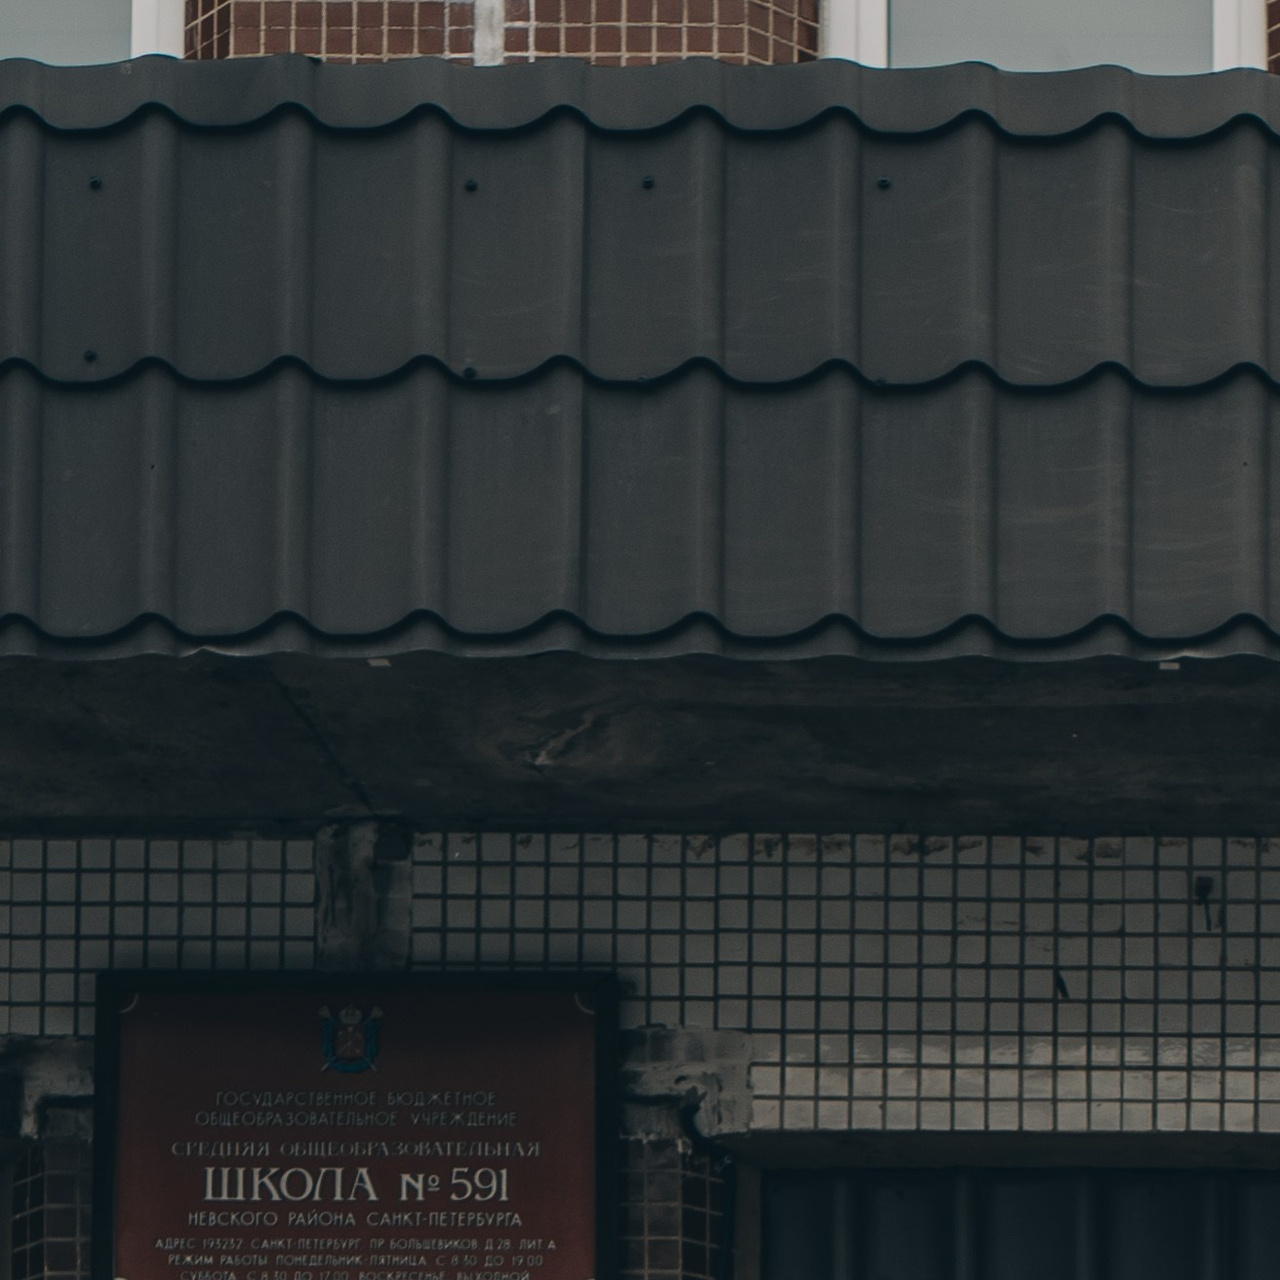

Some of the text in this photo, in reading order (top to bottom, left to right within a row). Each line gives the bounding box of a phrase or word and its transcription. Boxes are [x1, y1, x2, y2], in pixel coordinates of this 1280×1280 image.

[215, 1091, 496, 1107] ГОСУДАРСТВЕННОЕ БЮДЖЕТНОЕ
[195, 1111, 518, 1127] ОБЩЕОБРАЗОВАТЕЛЬНОЕ УЧРЕЖДЕНИЕ
[171, 1141, 541, 1158] СРЕДНЯЯ ОБЩЕОБРАЗОВАТЕЛЬНАЯ
[203, 1166, 510, 1202] ШКОЛА № 591
[188, 1208, 523, 1228] НЕВСКОГО РАЙОНА САНКТ-ПЕТЕРБУРГА
